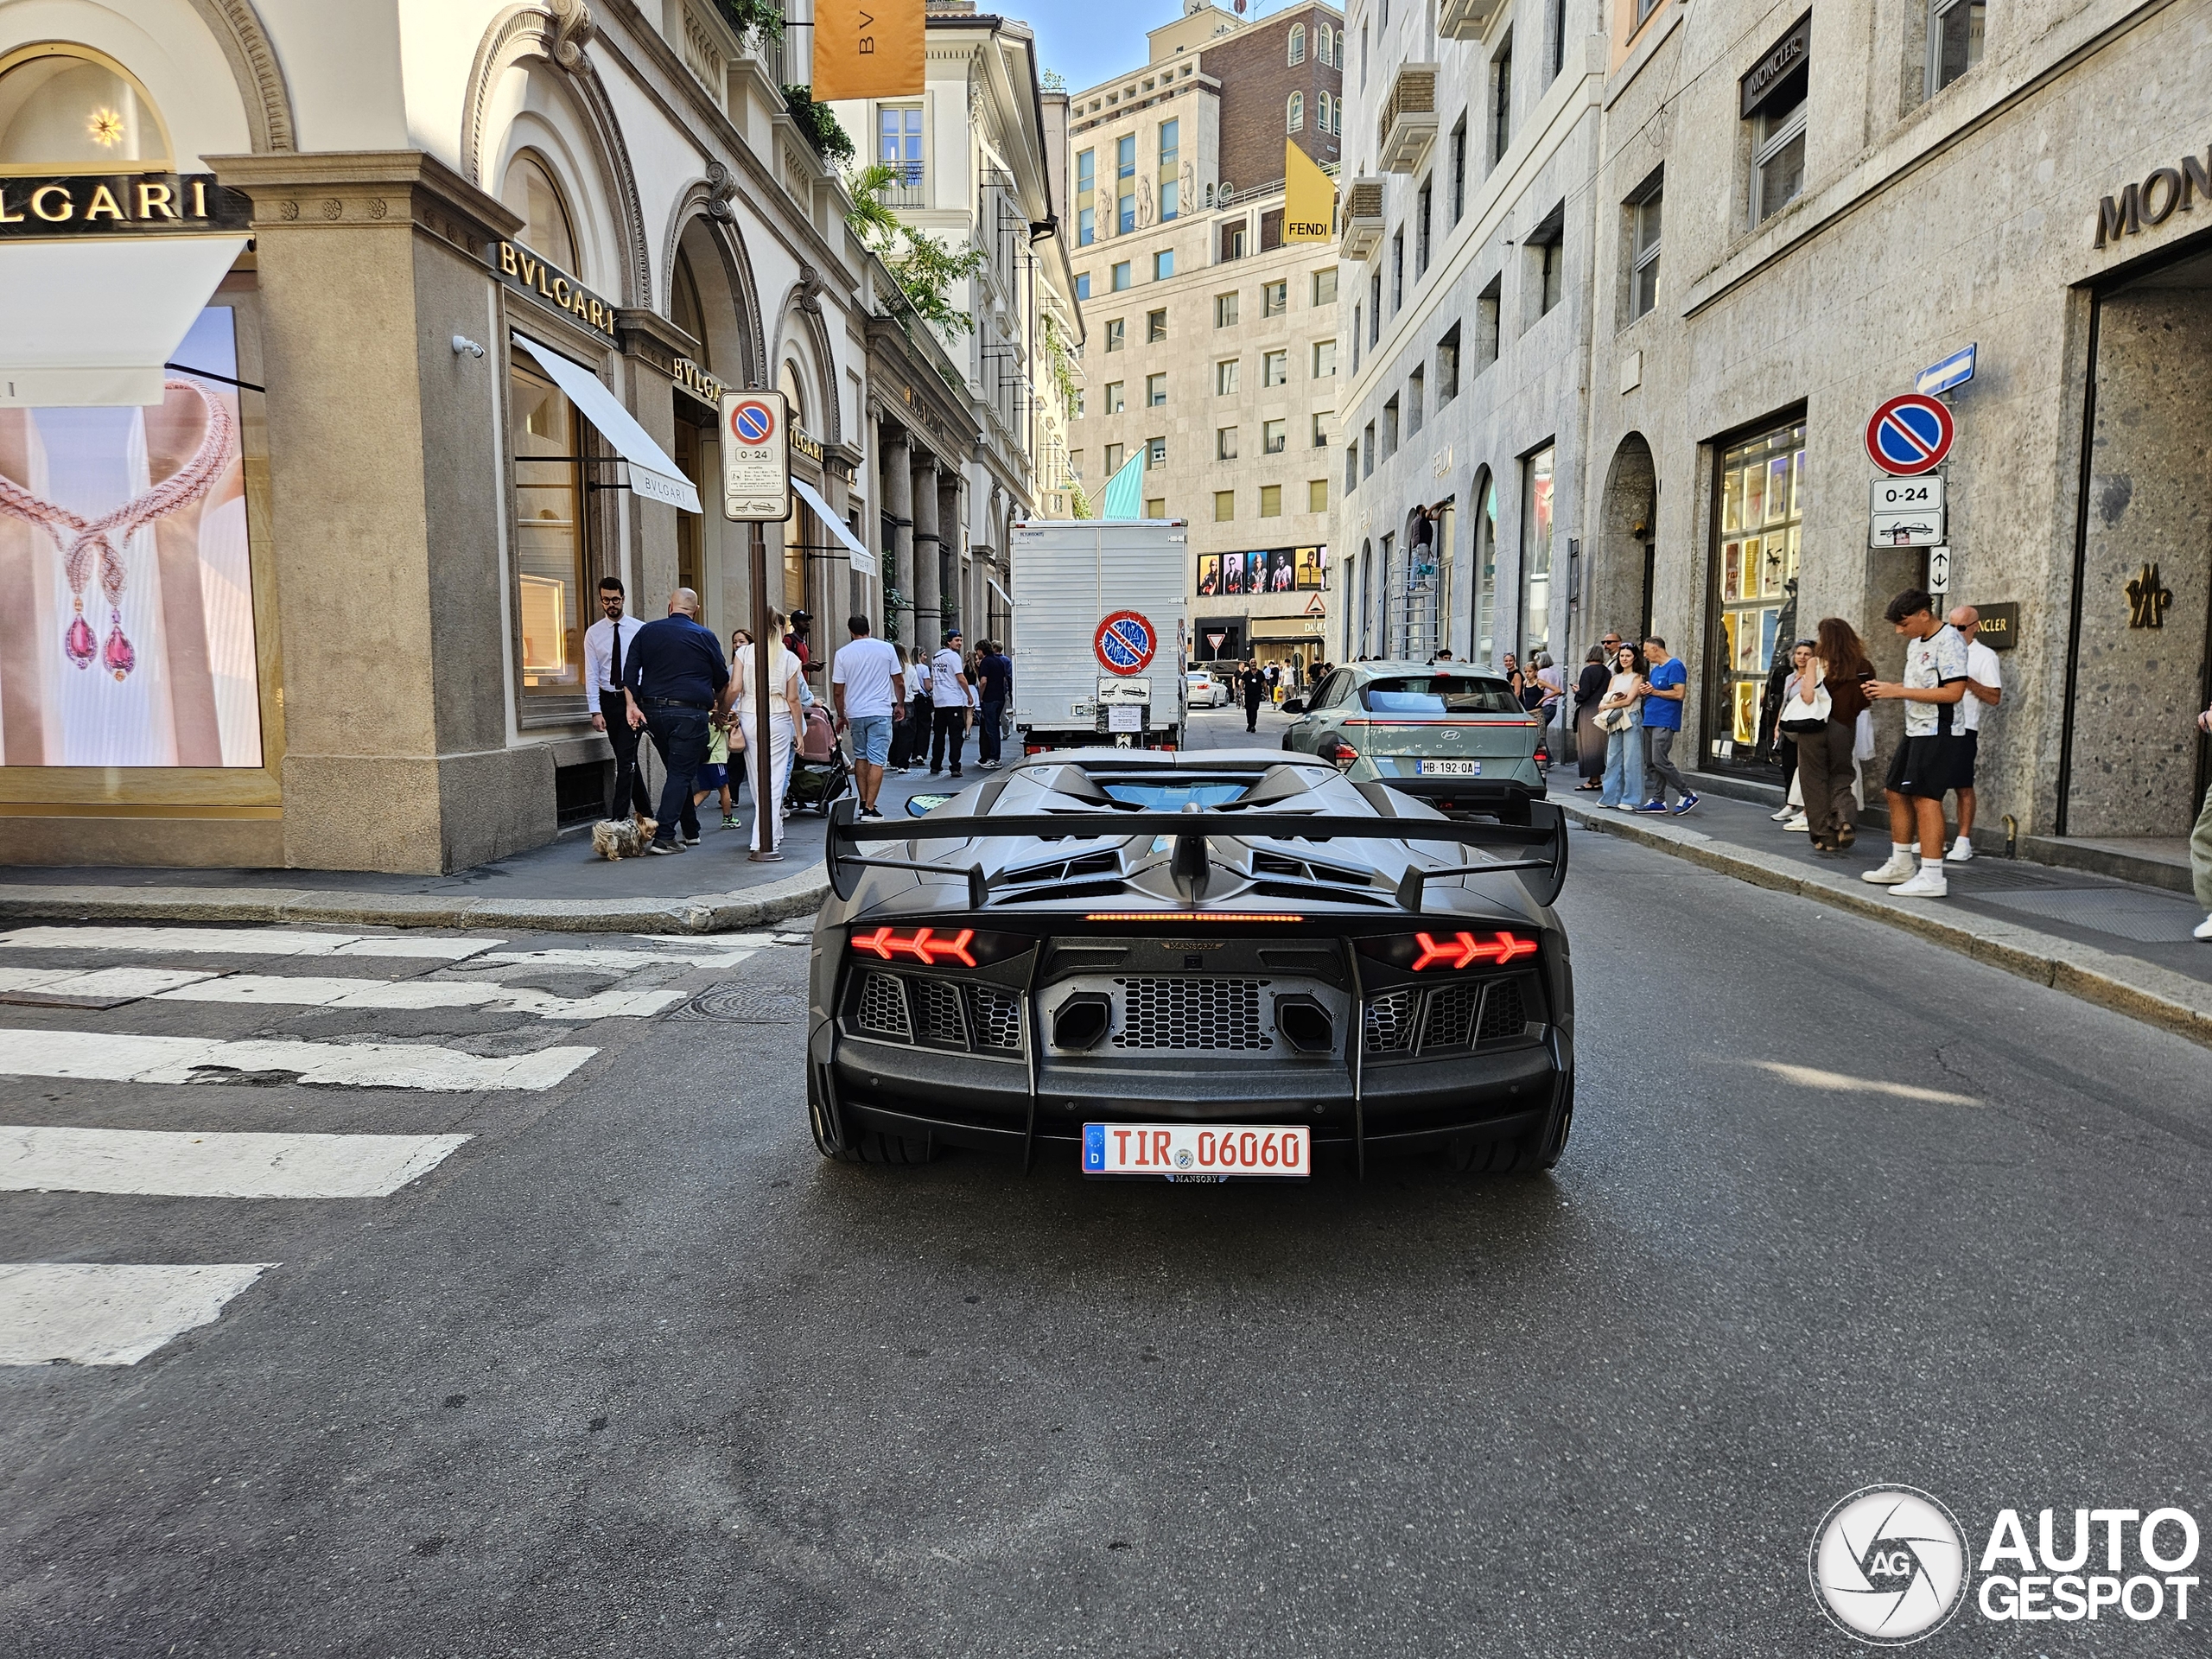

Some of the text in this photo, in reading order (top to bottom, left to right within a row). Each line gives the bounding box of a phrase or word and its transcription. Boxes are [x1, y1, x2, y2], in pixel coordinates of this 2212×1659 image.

[1751, 37, 1801, 96] MONCLER
[1289, 223, 1327, 236] FENDI
[499, 241, 614, 335] BVLGARI
[645, 477, 685, 502] BVLGARI
[1886, 487, 1929, 503] 0-24
[1091, 1154, 1099, 1164] D
[1114, 1130, 1172, 1166] TIR
[1198, 1131, 1299, 1167] 06060
